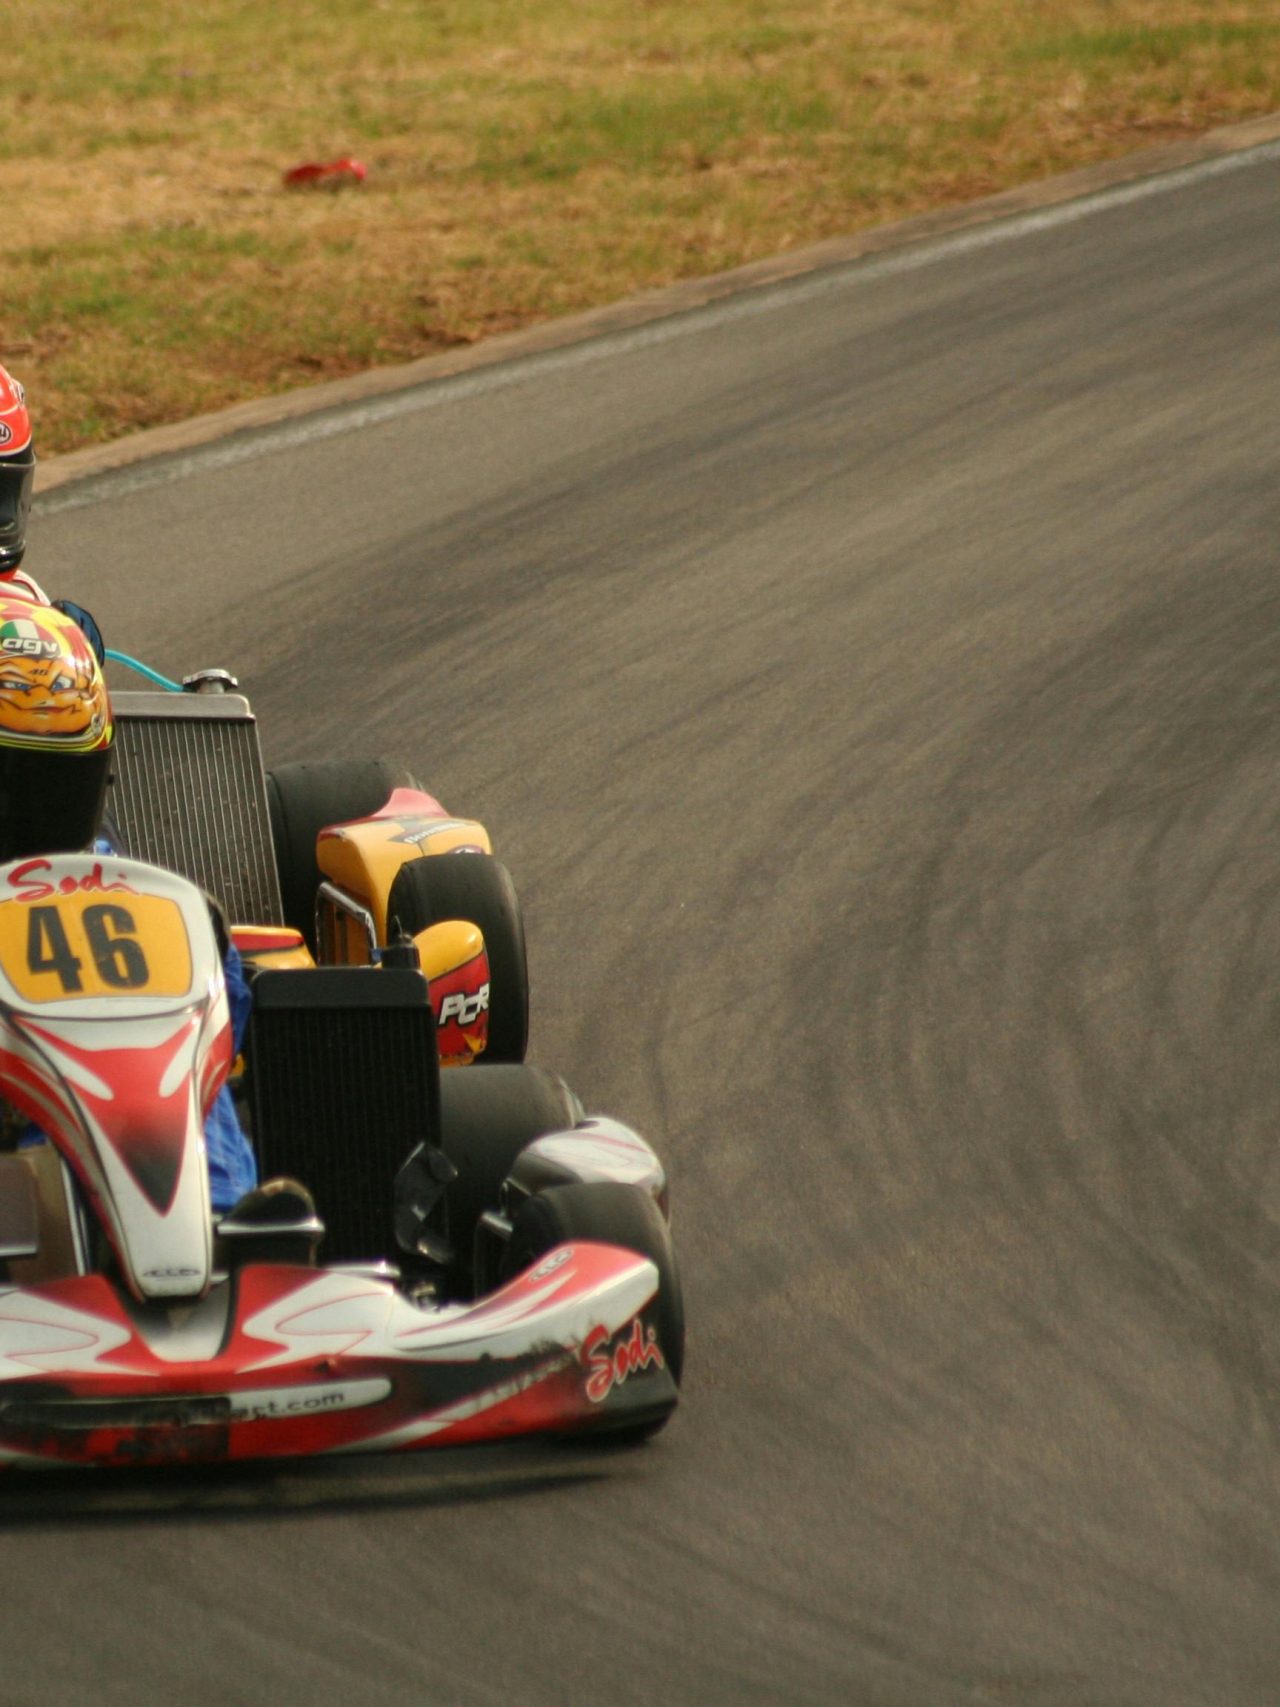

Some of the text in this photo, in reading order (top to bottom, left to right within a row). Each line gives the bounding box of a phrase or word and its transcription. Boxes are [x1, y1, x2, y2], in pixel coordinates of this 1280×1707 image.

[7, 858, 141, 903] Sodi
[26, 904, 149, 993] 46
[579, 1318, 663, 1402] Sodi
